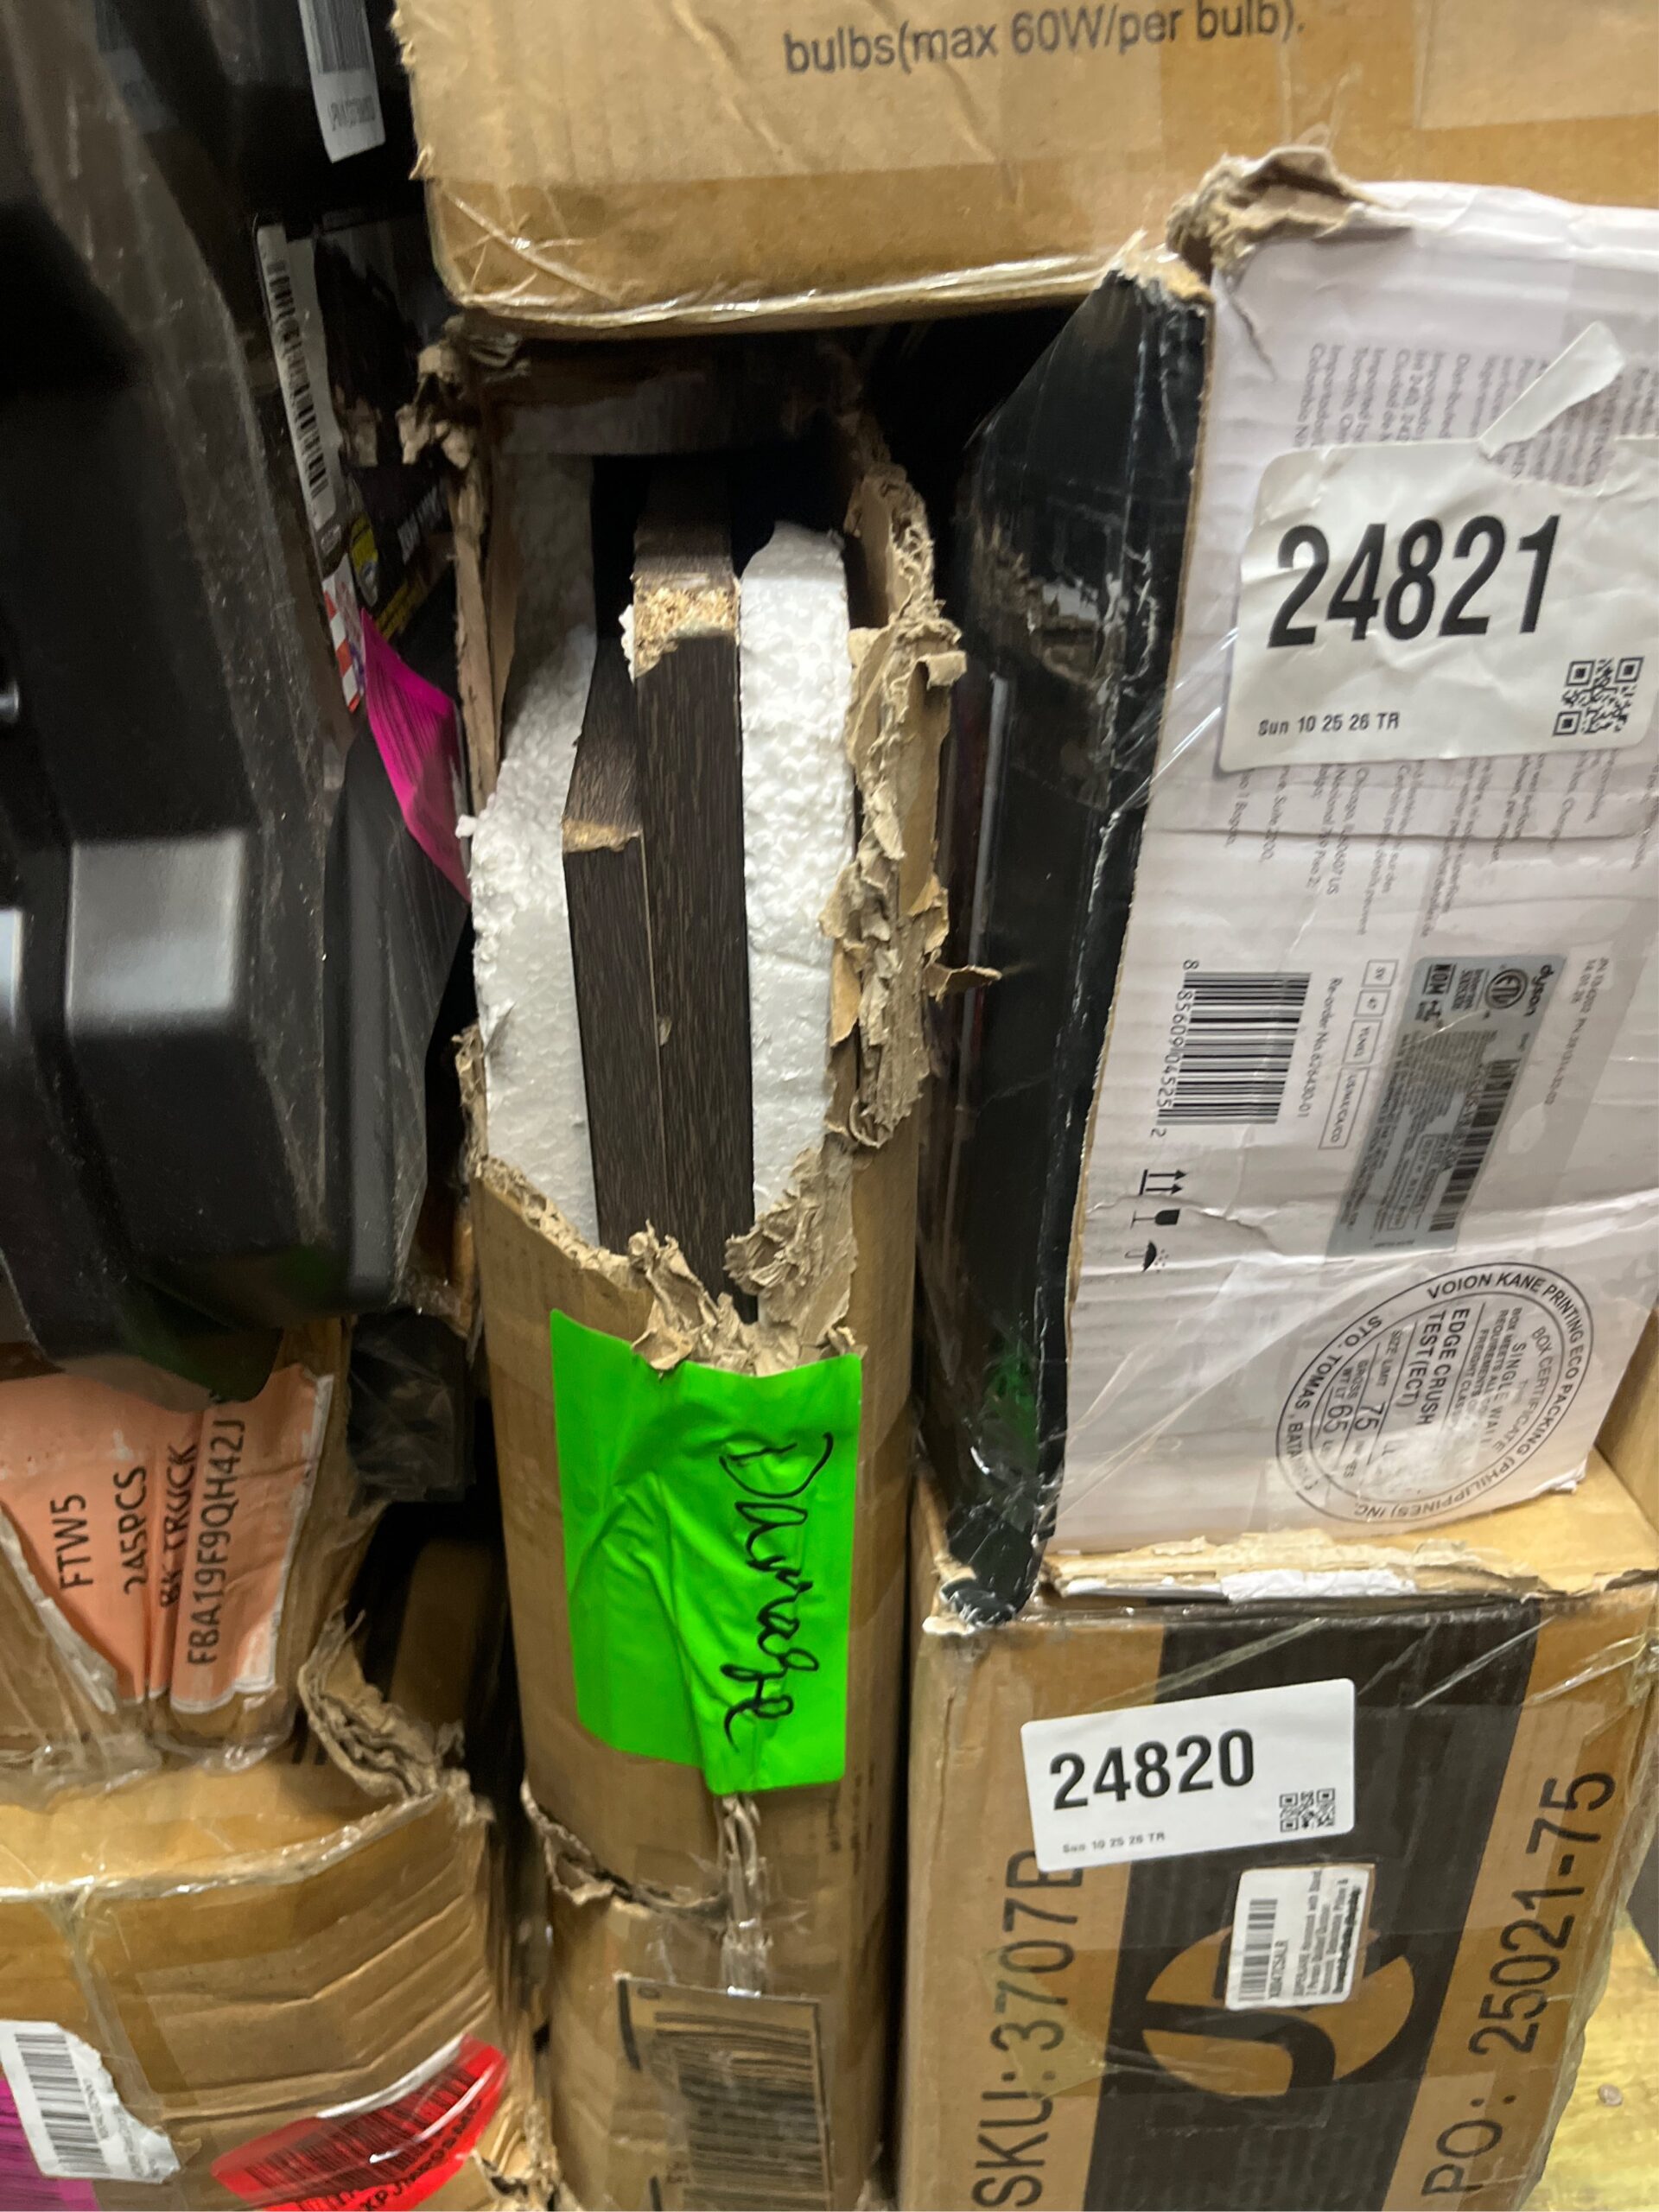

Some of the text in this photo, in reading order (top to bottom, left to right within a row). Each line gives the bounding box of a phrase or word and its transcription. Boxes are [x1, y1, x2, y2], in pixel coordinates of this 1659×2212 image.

[784, 0, 1306, 73] bulbs(max 60W/per bulb).
[1268, 513, 1560, 650] 24821
[1297, 715, 1317, 733] 10
[1322, 714, 1343, 732] 25
[1348, 713, 1370, 731] 26
[1376, 712, 1400, 729] TR
[1183, 960, 1199, 970] 8
[1519, 964, 1556, 1016] dyson
[1151, 1128, 1166, 1137] 2
[1496, 1272, 1547, 1294] KANE
[1338, 1315, 1382, 1349] STO.
[1532, 1325, 1553, 1357] BOX
[1542, 1284, 1584, 1344] PRINTING
[1294, 1353, 1343, 1410] TOMAS
[1415, 1307, 1471, 1426] EDGE CRUSH
[1565, 1344, 1584, 1380] ECO
[1322, 1404, 1353, 1433] 65
[1354, 1402, 1388, 1431] 75
[1516, 1384, 1573, 1456] PACKING
[49, 1493, 92, 1590] FTW5
[187, 1419, 245, 1665] FBA19F9QH42J
[717, 1432, 834, 1754] Damage
[1049, 1728, 1256, 1812] 24820
[1422, 1770, 1616, 2196] PO: 25021-75
